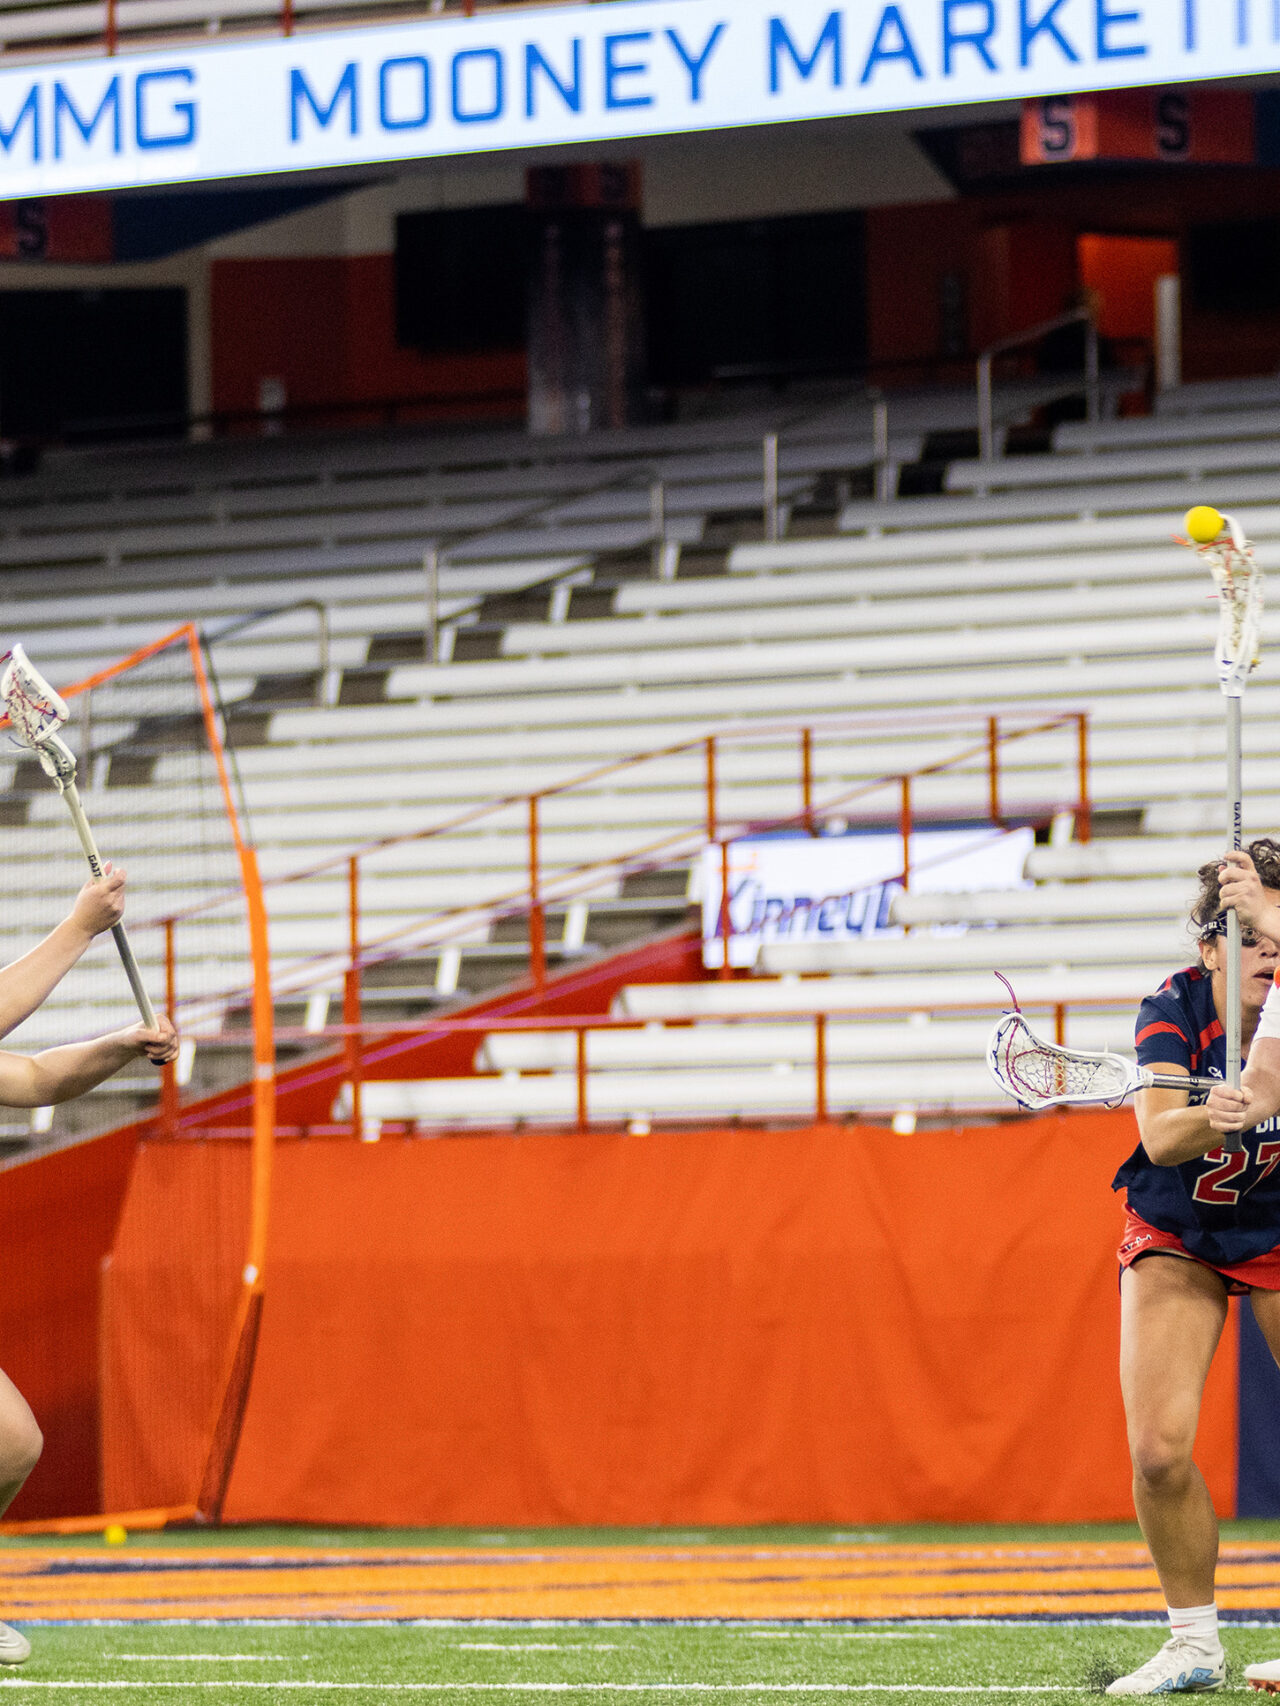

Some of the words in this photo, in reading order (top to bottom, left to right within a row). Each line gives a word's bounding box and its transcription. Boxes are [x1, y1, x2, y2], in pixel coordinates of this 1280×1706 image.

[289, 22, 727, 144] MOONEY
[1039, 95, 1077, 162] S
[1154, 91, 1190, 160] S
